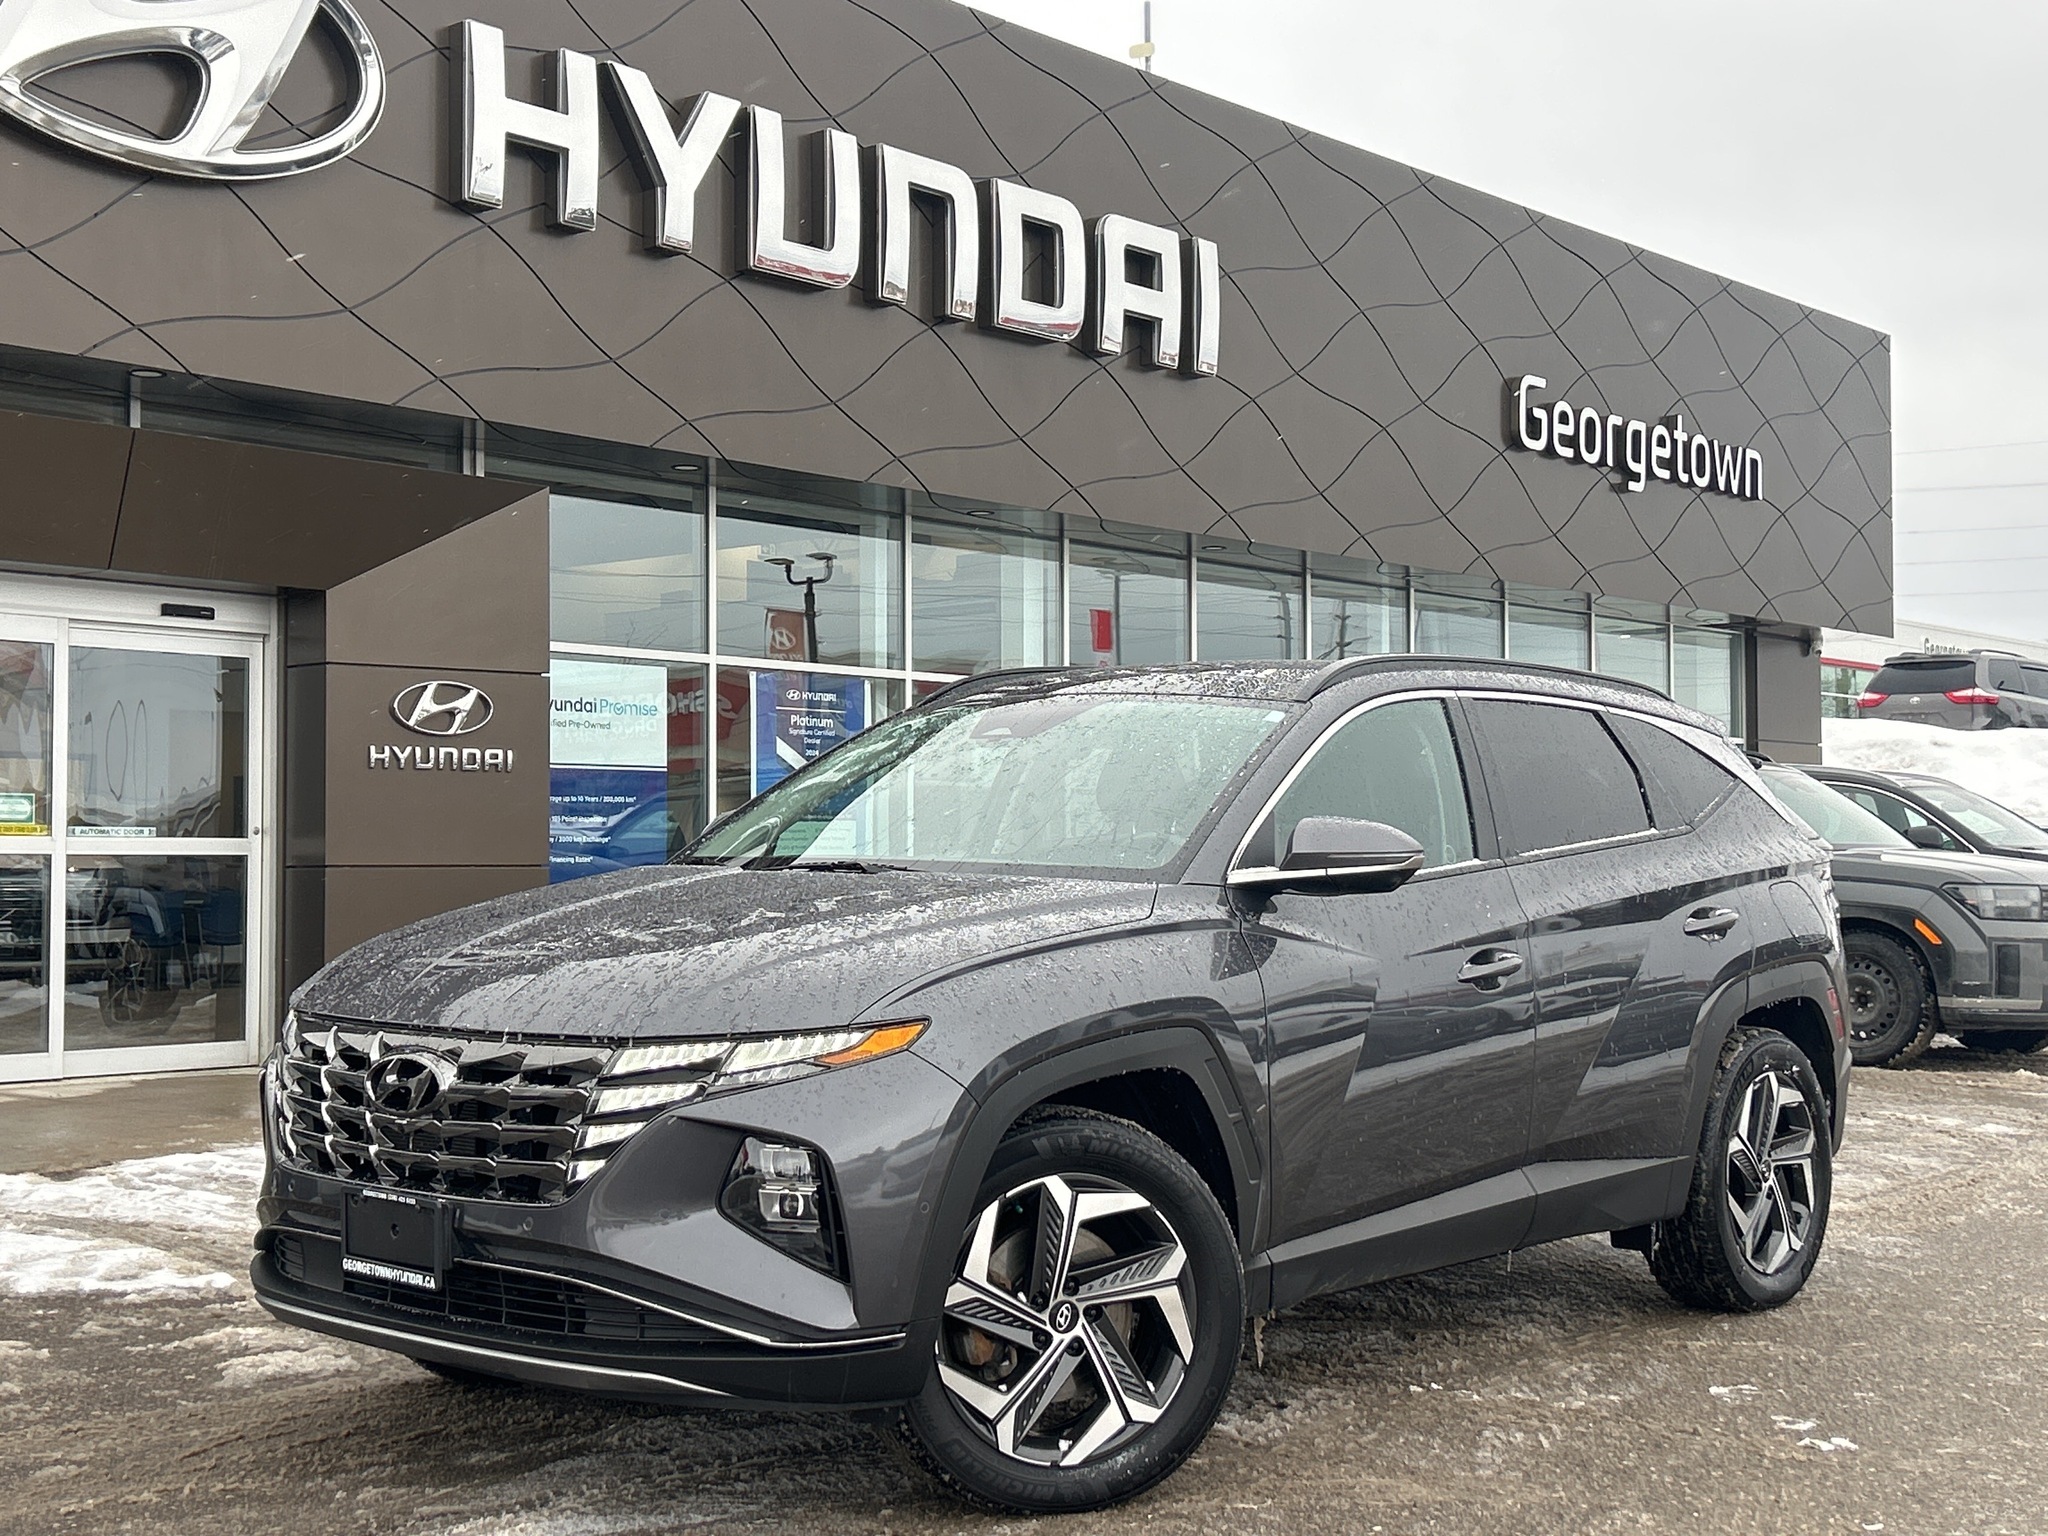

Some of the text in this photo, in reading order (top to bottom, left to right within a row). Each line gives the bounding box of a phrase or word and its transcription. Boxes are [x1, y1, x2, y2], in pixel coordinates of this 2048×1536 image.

[460, 18, 1221, 378] HYUNDAI
[1518, 374, 1764, 501] Georgetown
[801, 691, 837, 702] HYUNDAI
[600, 698, 658, 717] Promise
[568, 719, 611, 730] Pre-Owned
[790, 714, 834, 728] Platinum
[813, 728, 836, 737] Certified
[368, 744, 514, 773] HYUNDAI
[79, 828, 122, 836] AUTOMATIC
[342, 1257, 436, 1290] GEORGETOWNHYUNDAI.CA
